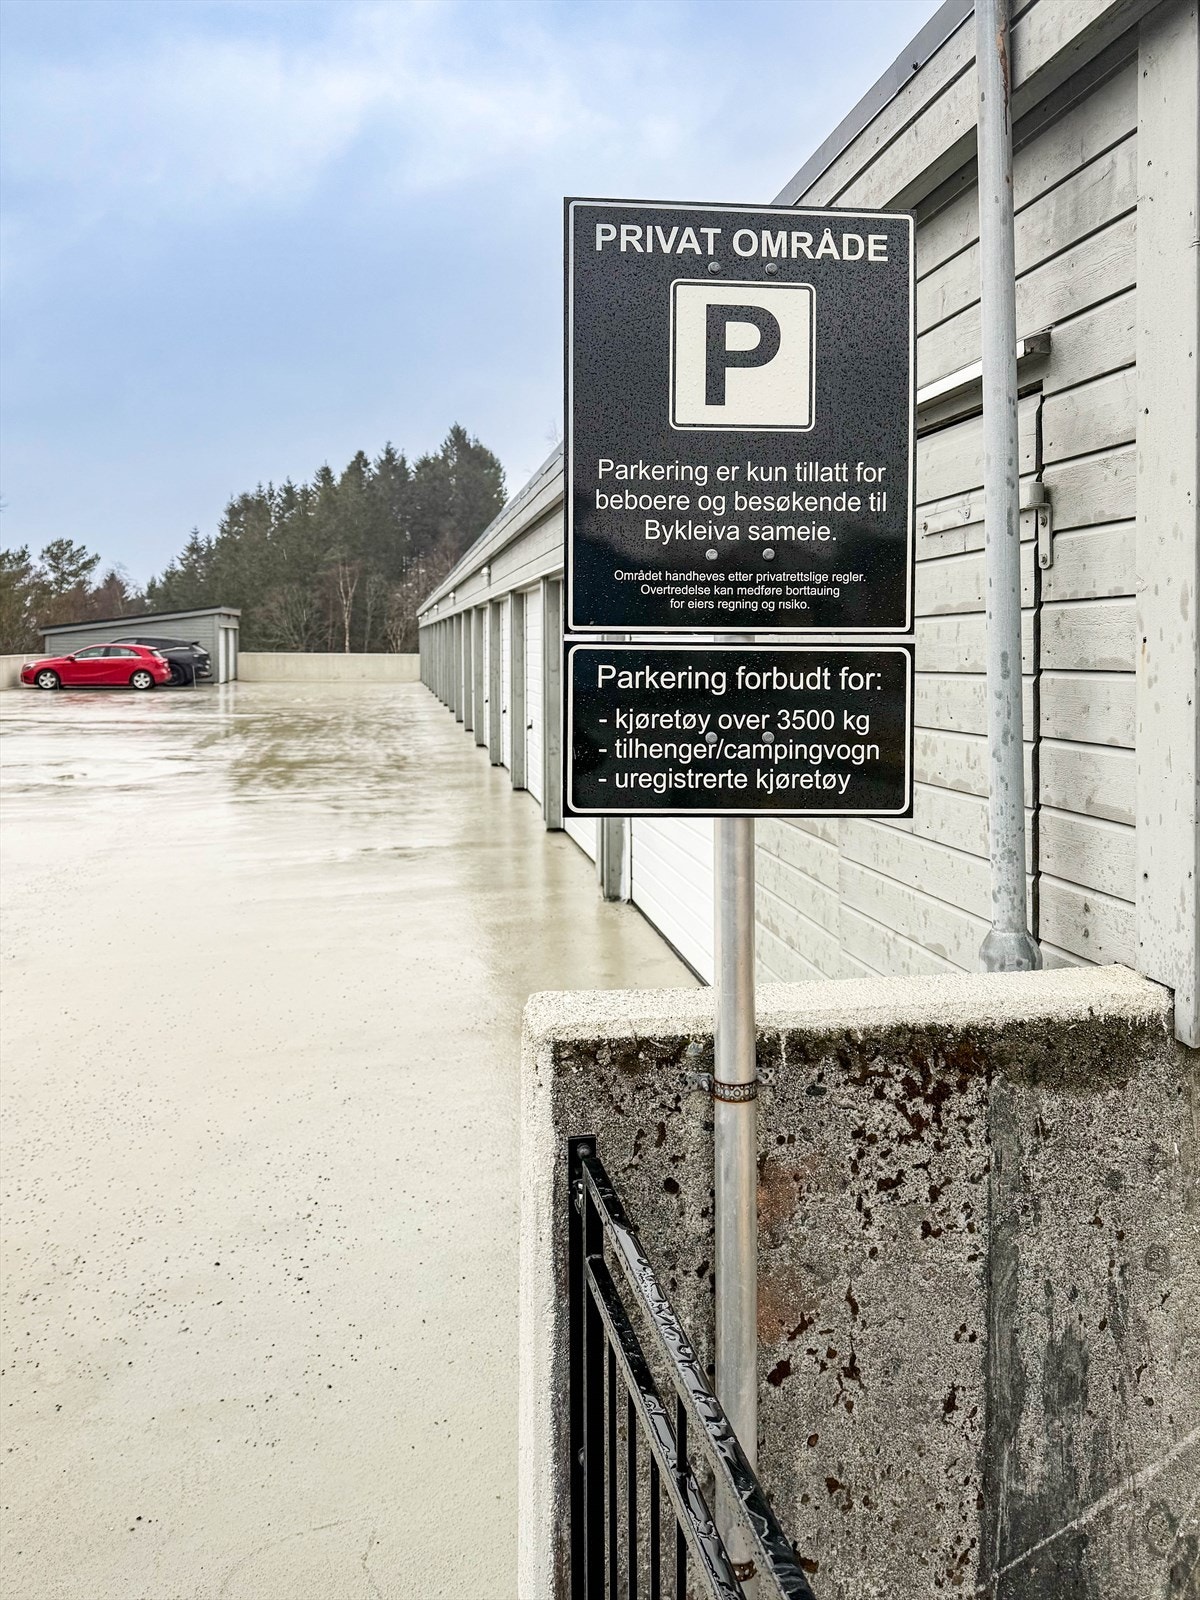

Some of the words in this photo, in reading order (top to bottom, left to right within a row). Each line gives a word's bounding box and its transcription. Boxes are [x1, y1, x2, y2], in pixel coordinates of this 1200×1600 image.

[594, 223, 722, 255] PRIVAT
[732, 227, 888, 262] OMRÅDE
[705, 304, 781, 406] P
[597, 459, 709, 487] Parkering
[716, 464, 739, 482] er
[747, 460, 788, 482] kun
[795, 460, 849, 482] tillatt
[855, 462, 887, 483] for
[595, 490, 690, 511] beboere
[698, 495, 726, 517] og
[734, 491, 862, 513] besøkende
[868, 491, 888, 513] til
[644, 520, 740, 546] Bykleiva
[748, 524, 838, 542] sameie.
[614, 569, 663, 582] Området
[664, 570, 726, 582] handheves
[727, 570, 754, 582] etter
[755, 570, 829, 585] privatrettslige
[831, 570, 866, 585] regler.
[640, 584, 711, 596] Overtredelse
[713, 584, 735, 596] kan
[736, 584, 783, 597] medføre
[785, 585, 840, 599] borttauing
[669, 598, 686, 610] for
[687, 599, 715, 610] eiers
[717, 599, 759, 612] regning
[760, 601, 776, 612] og
[777, 598, 810, 610] risiko.
[597, 664, 727, 695] Parkering
[735, 666, 831, 690] forbudt
[839, 666, 883, 691] for:
[615, 709, 711, 734] kjøretøy
[718, 715, 770, 730] over
[776, 709, 835, 731] 3500
[843, 709, 870, 735] kg
[615, 738, 880, 766] tilhenger/campingvogn
[615, 768, 748, 794] uregistrerte
[756, 769, 851, 795] kjøretøy
